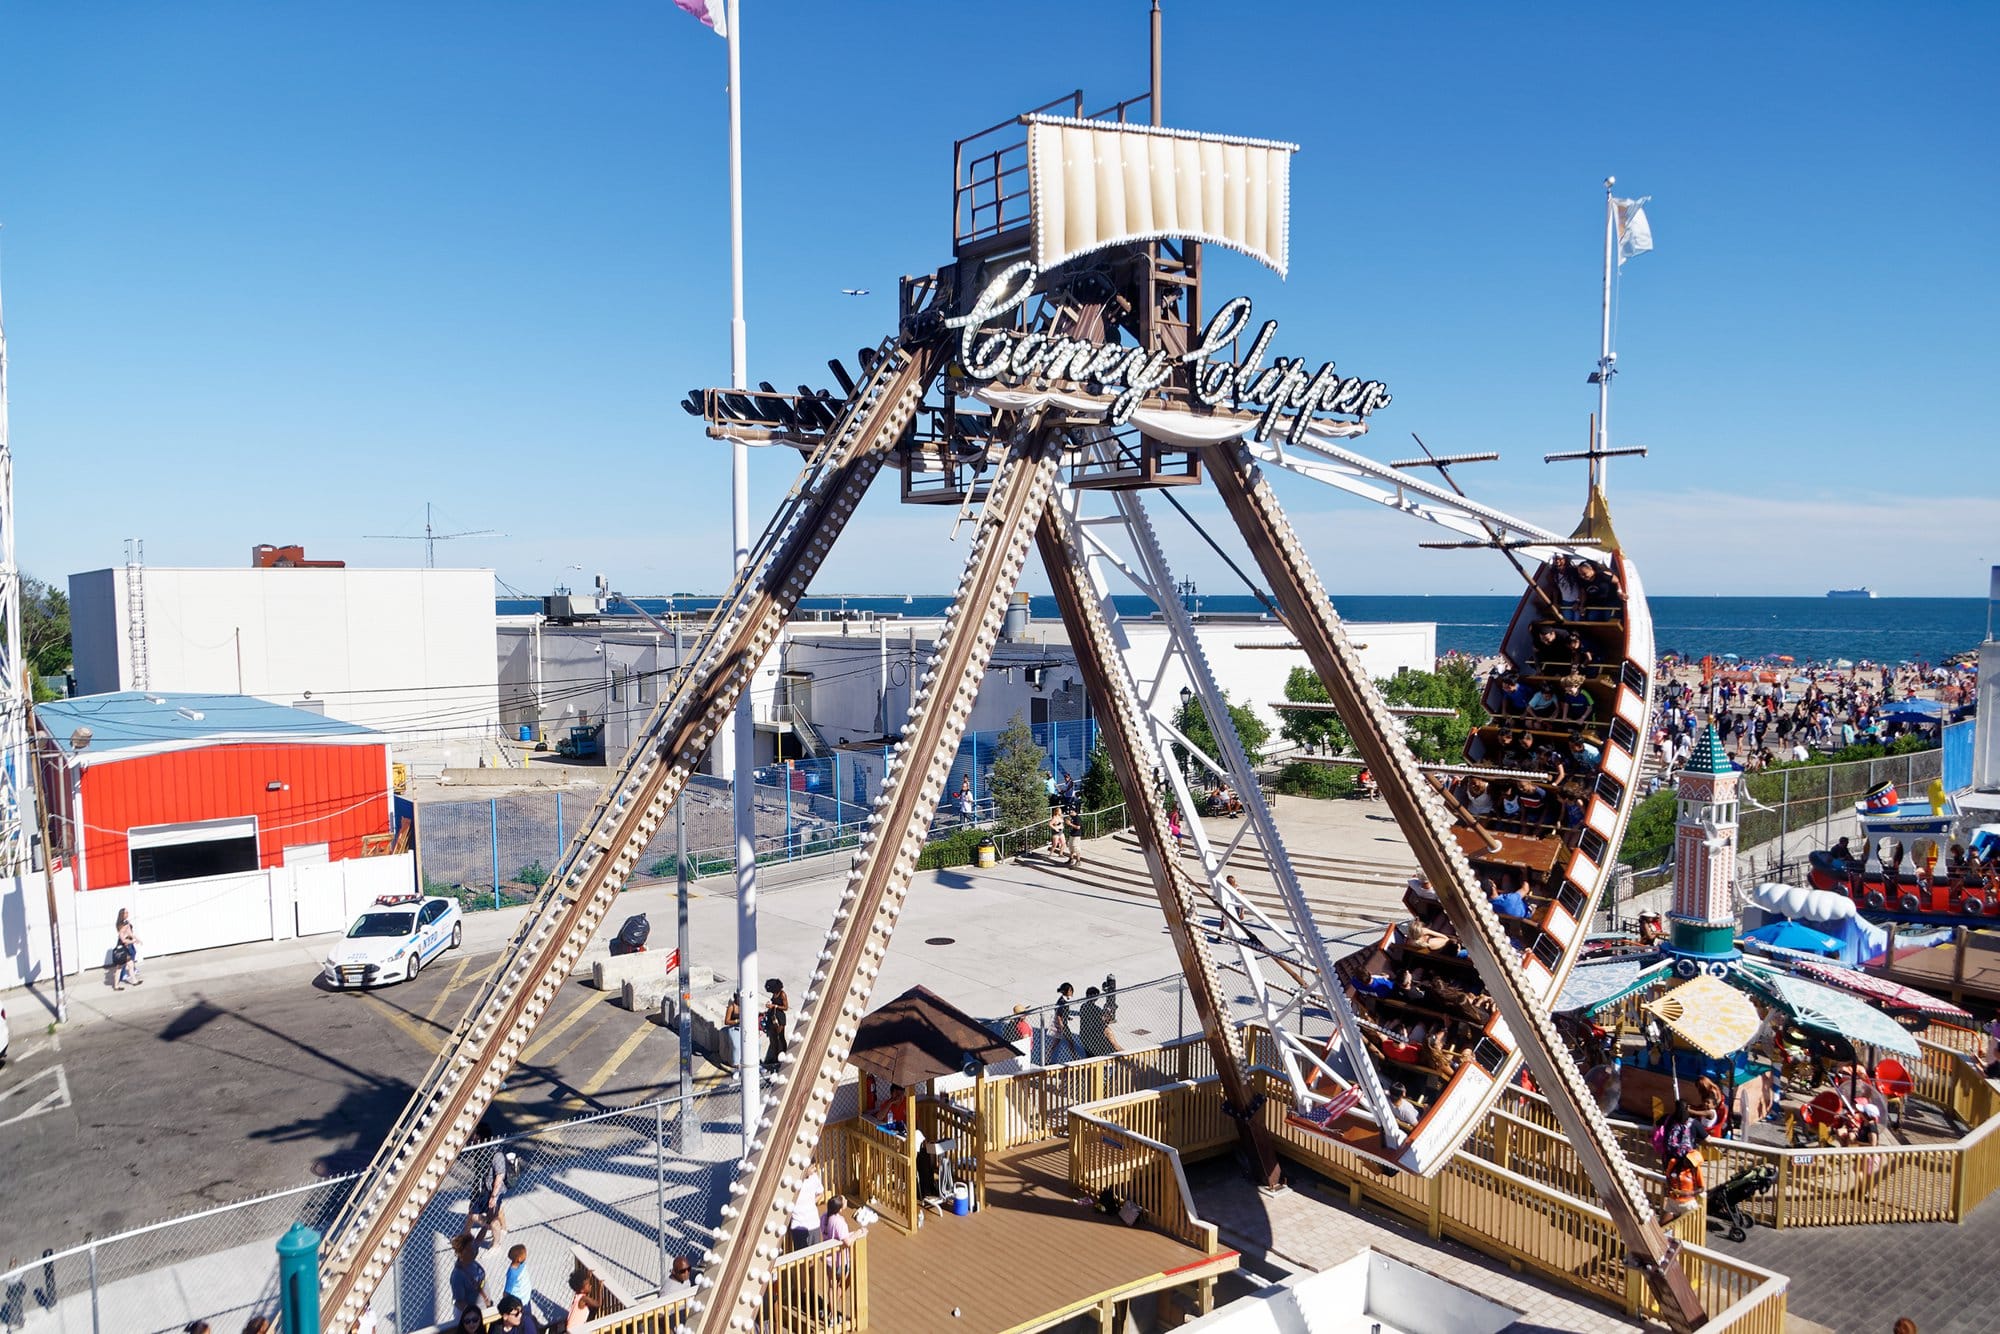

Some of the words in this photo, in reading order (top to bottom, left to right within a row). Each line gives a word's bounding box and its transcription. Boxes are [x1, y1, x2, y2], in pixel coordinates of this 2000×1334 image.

[945, 260, 1173, 426] Coney
[1182, 296, 1394, 445] Clipper
[1873, 797, 1890, 808] 10
[1793, 1155, 1813, 1164] EXIT
